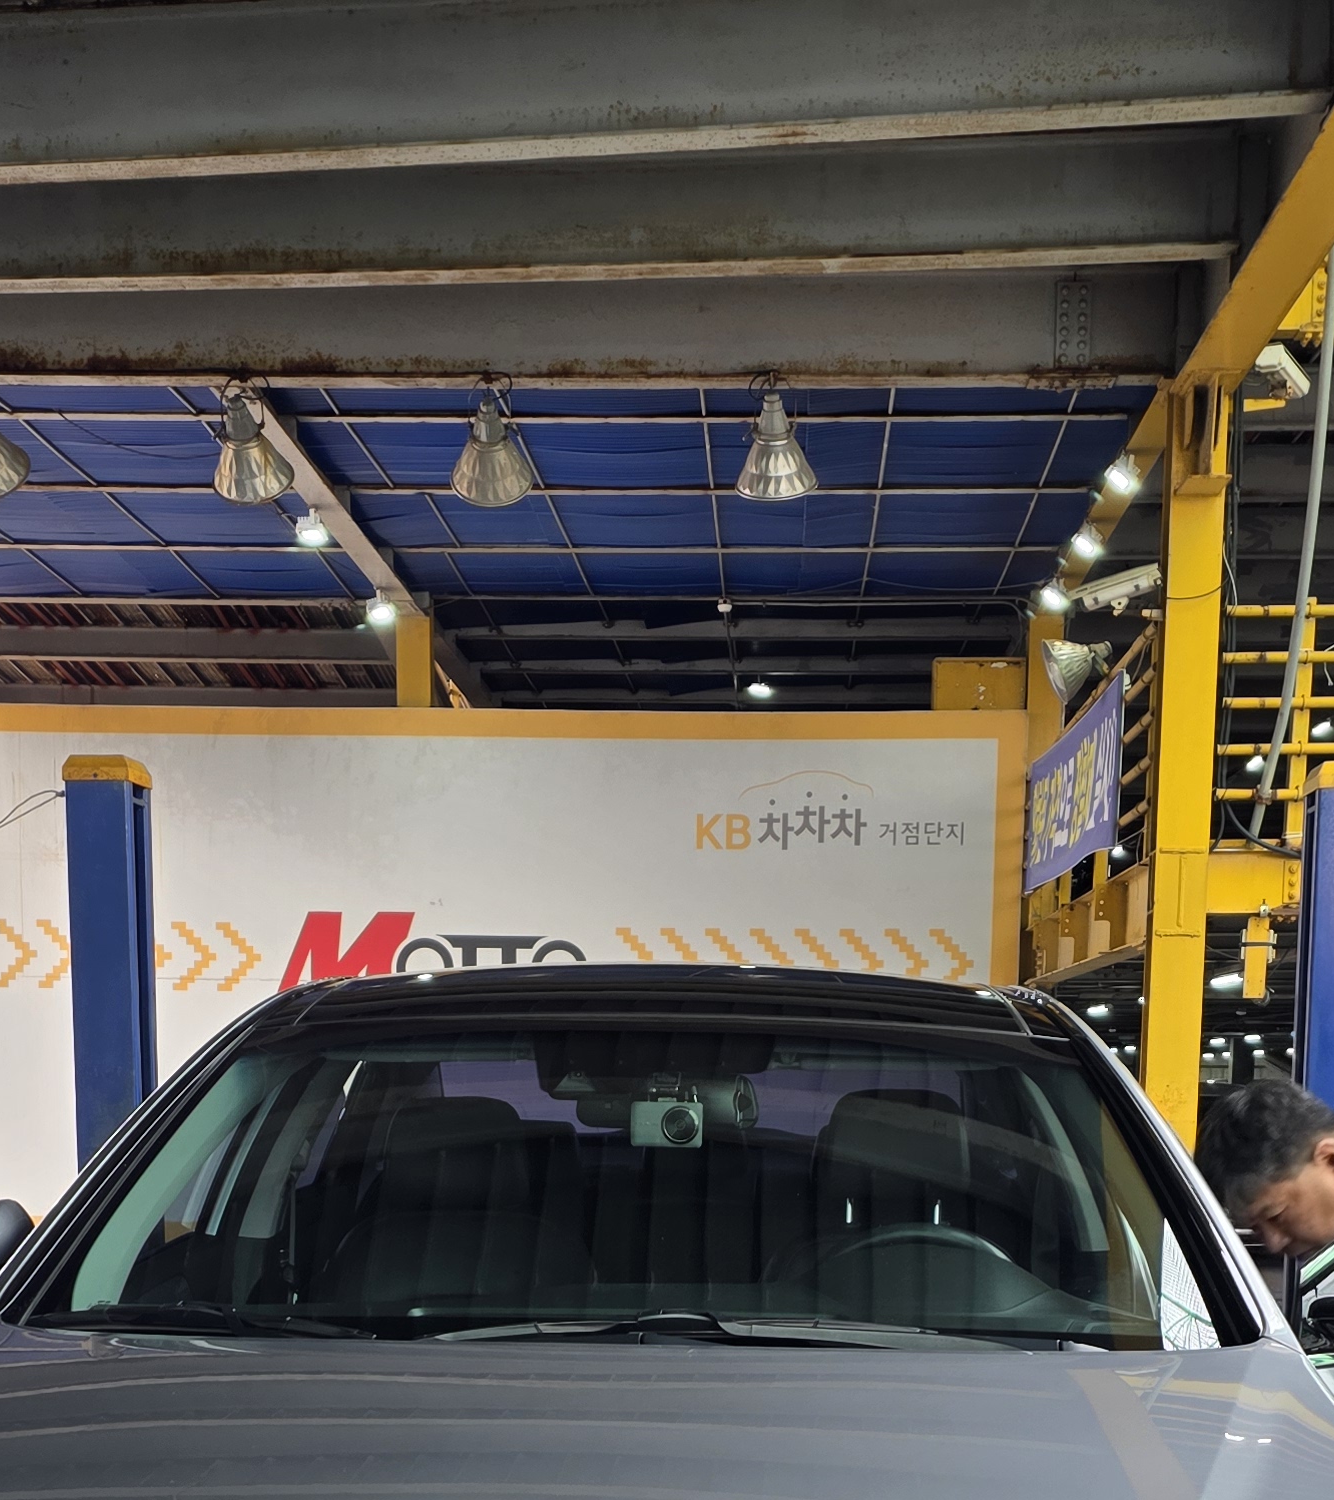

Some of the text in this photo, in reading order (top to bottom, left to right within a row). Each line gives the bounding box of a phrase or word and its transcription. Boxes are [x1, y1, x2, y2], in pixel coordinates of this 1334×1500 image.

[695, 791, 965, 850] KB 차차차 거점단지
